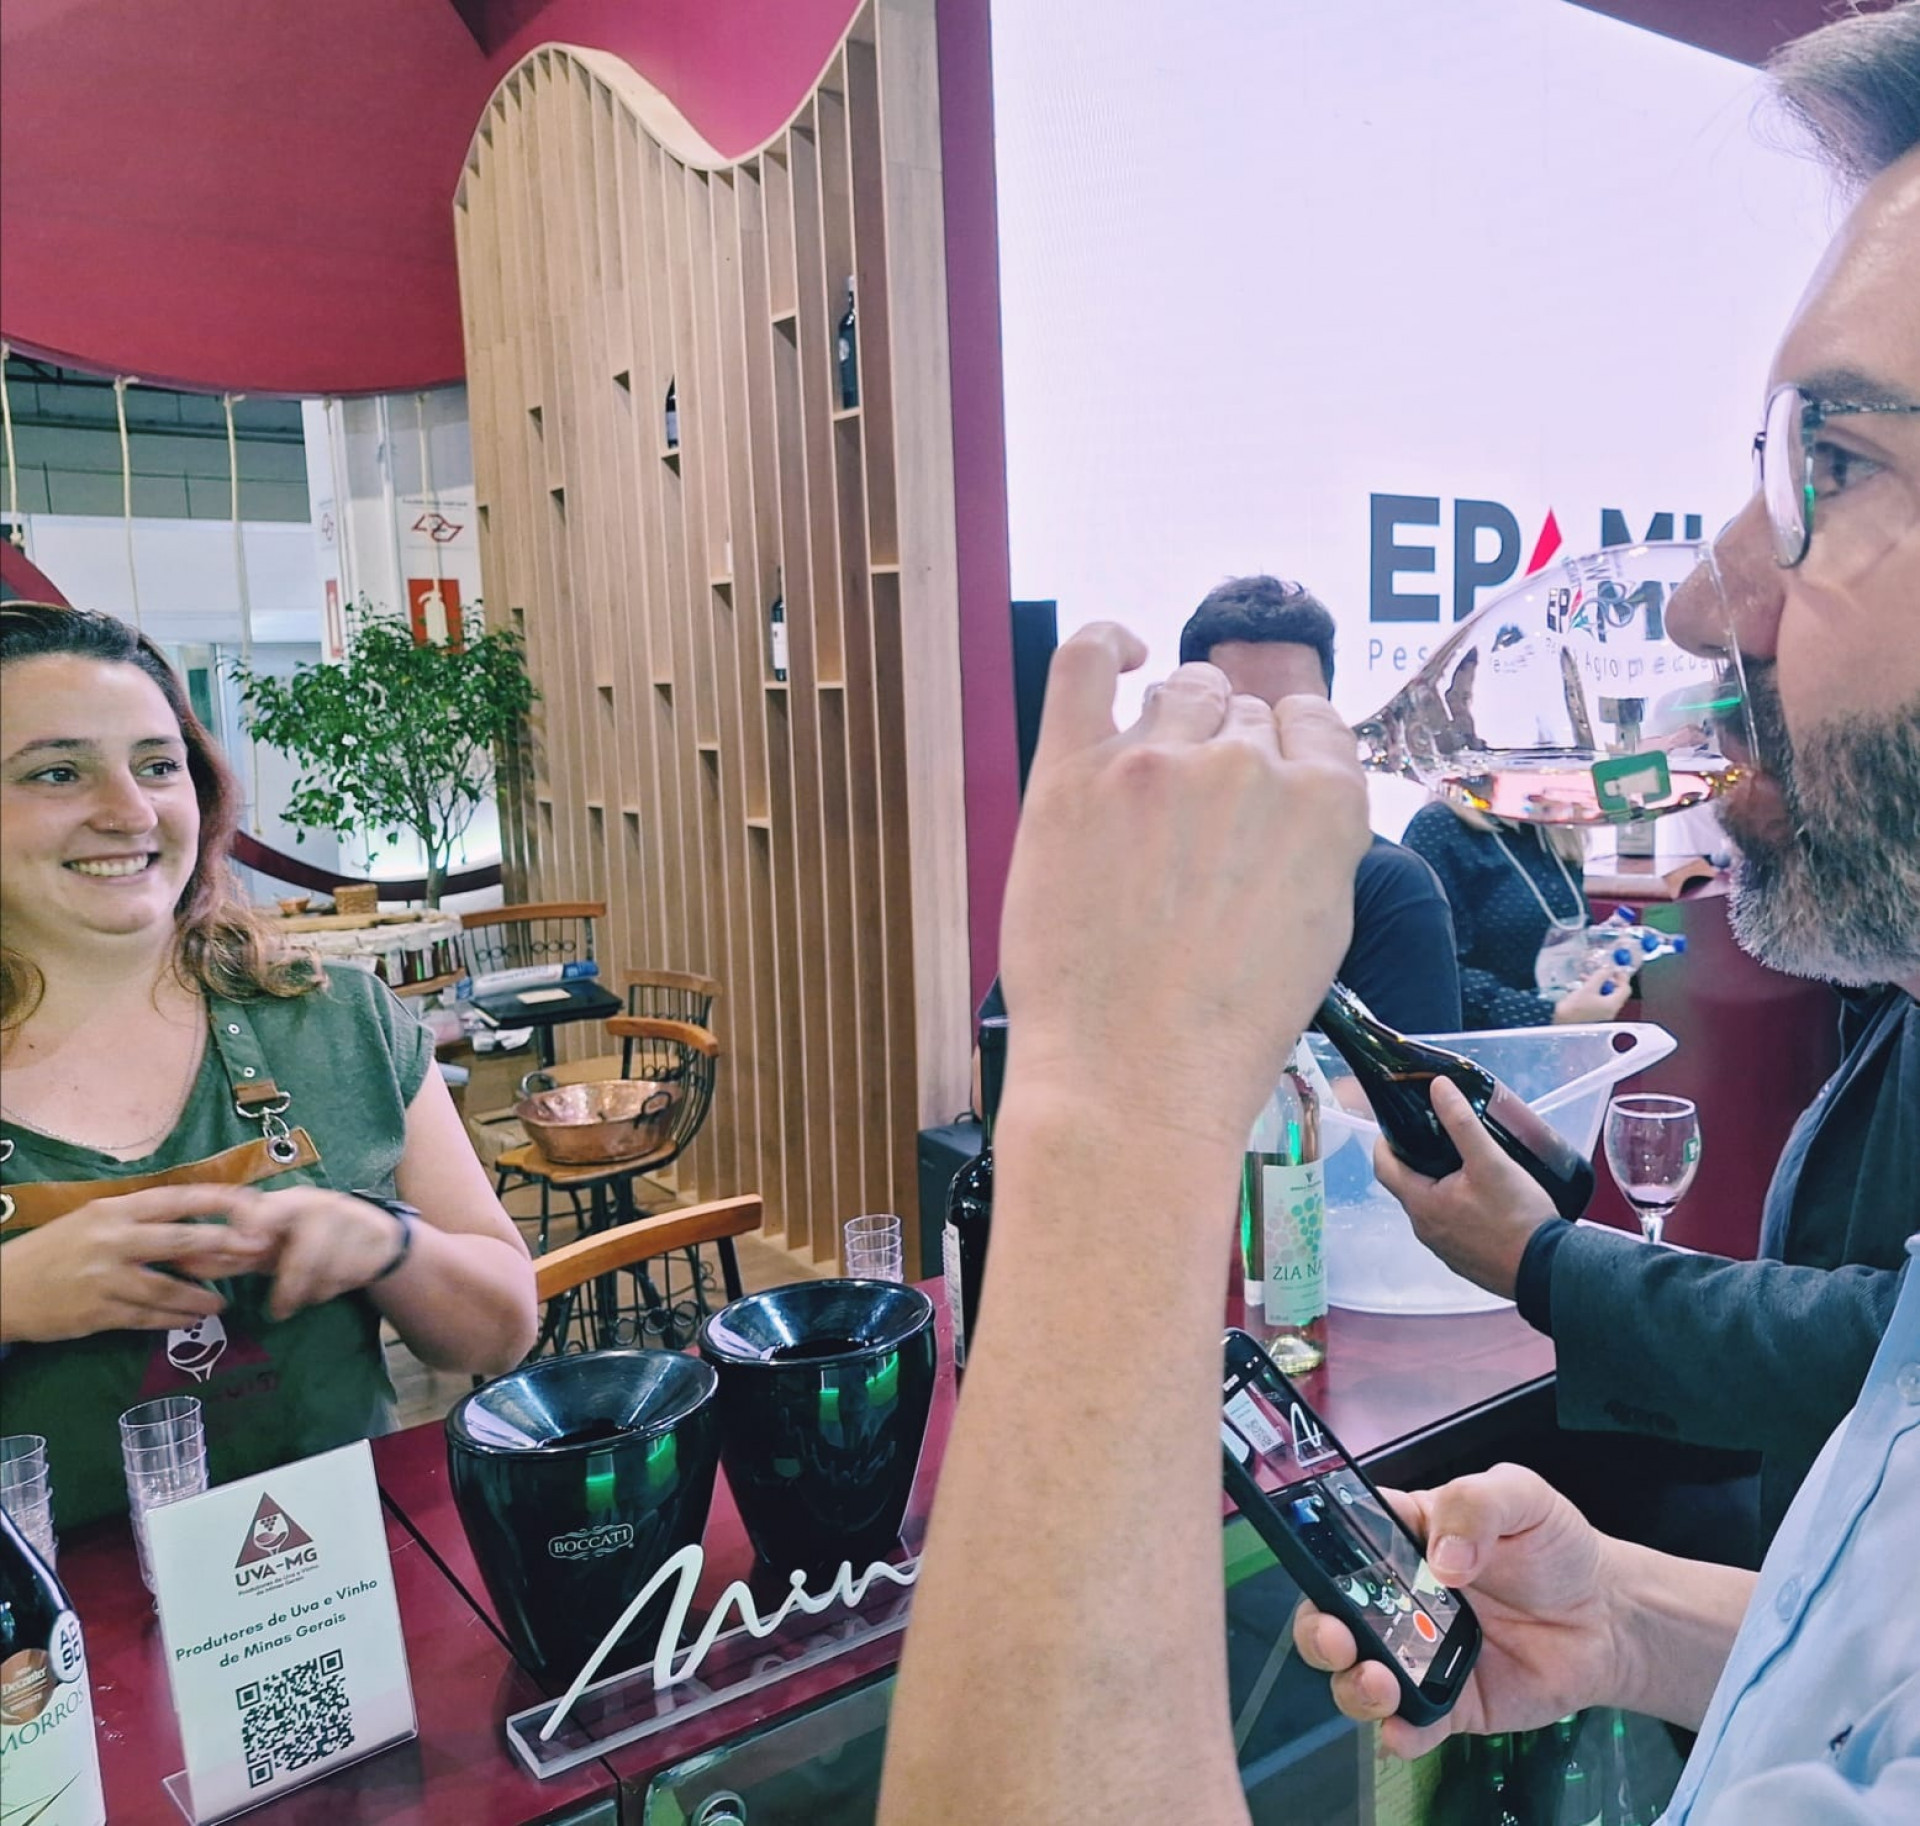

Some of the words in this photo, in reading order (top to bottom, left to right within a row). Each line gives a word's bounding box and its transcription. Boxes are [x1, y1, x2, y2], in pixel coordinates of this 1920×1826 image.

[1272, 1265, 1302, 1281] ZIA
[554, 1529, 628, 1553] BOCCATI
[235, 1547, 318, 1587] UVA-MG
[175, 1622, 264, 1661] Produtores
[267, 1612, 287, 1627] de
[290, 1602, 320, 1618] Uva
[323, 1596, 333, 1606] e
[336, 1578, 378, 1600] Vinho
[219, 1653, 239, 1668] de
[243, 1633, 292, 1659] Minas
[296, 1612, 347, 1638] Gerais
[540, 1543, 922, 1742] Min
